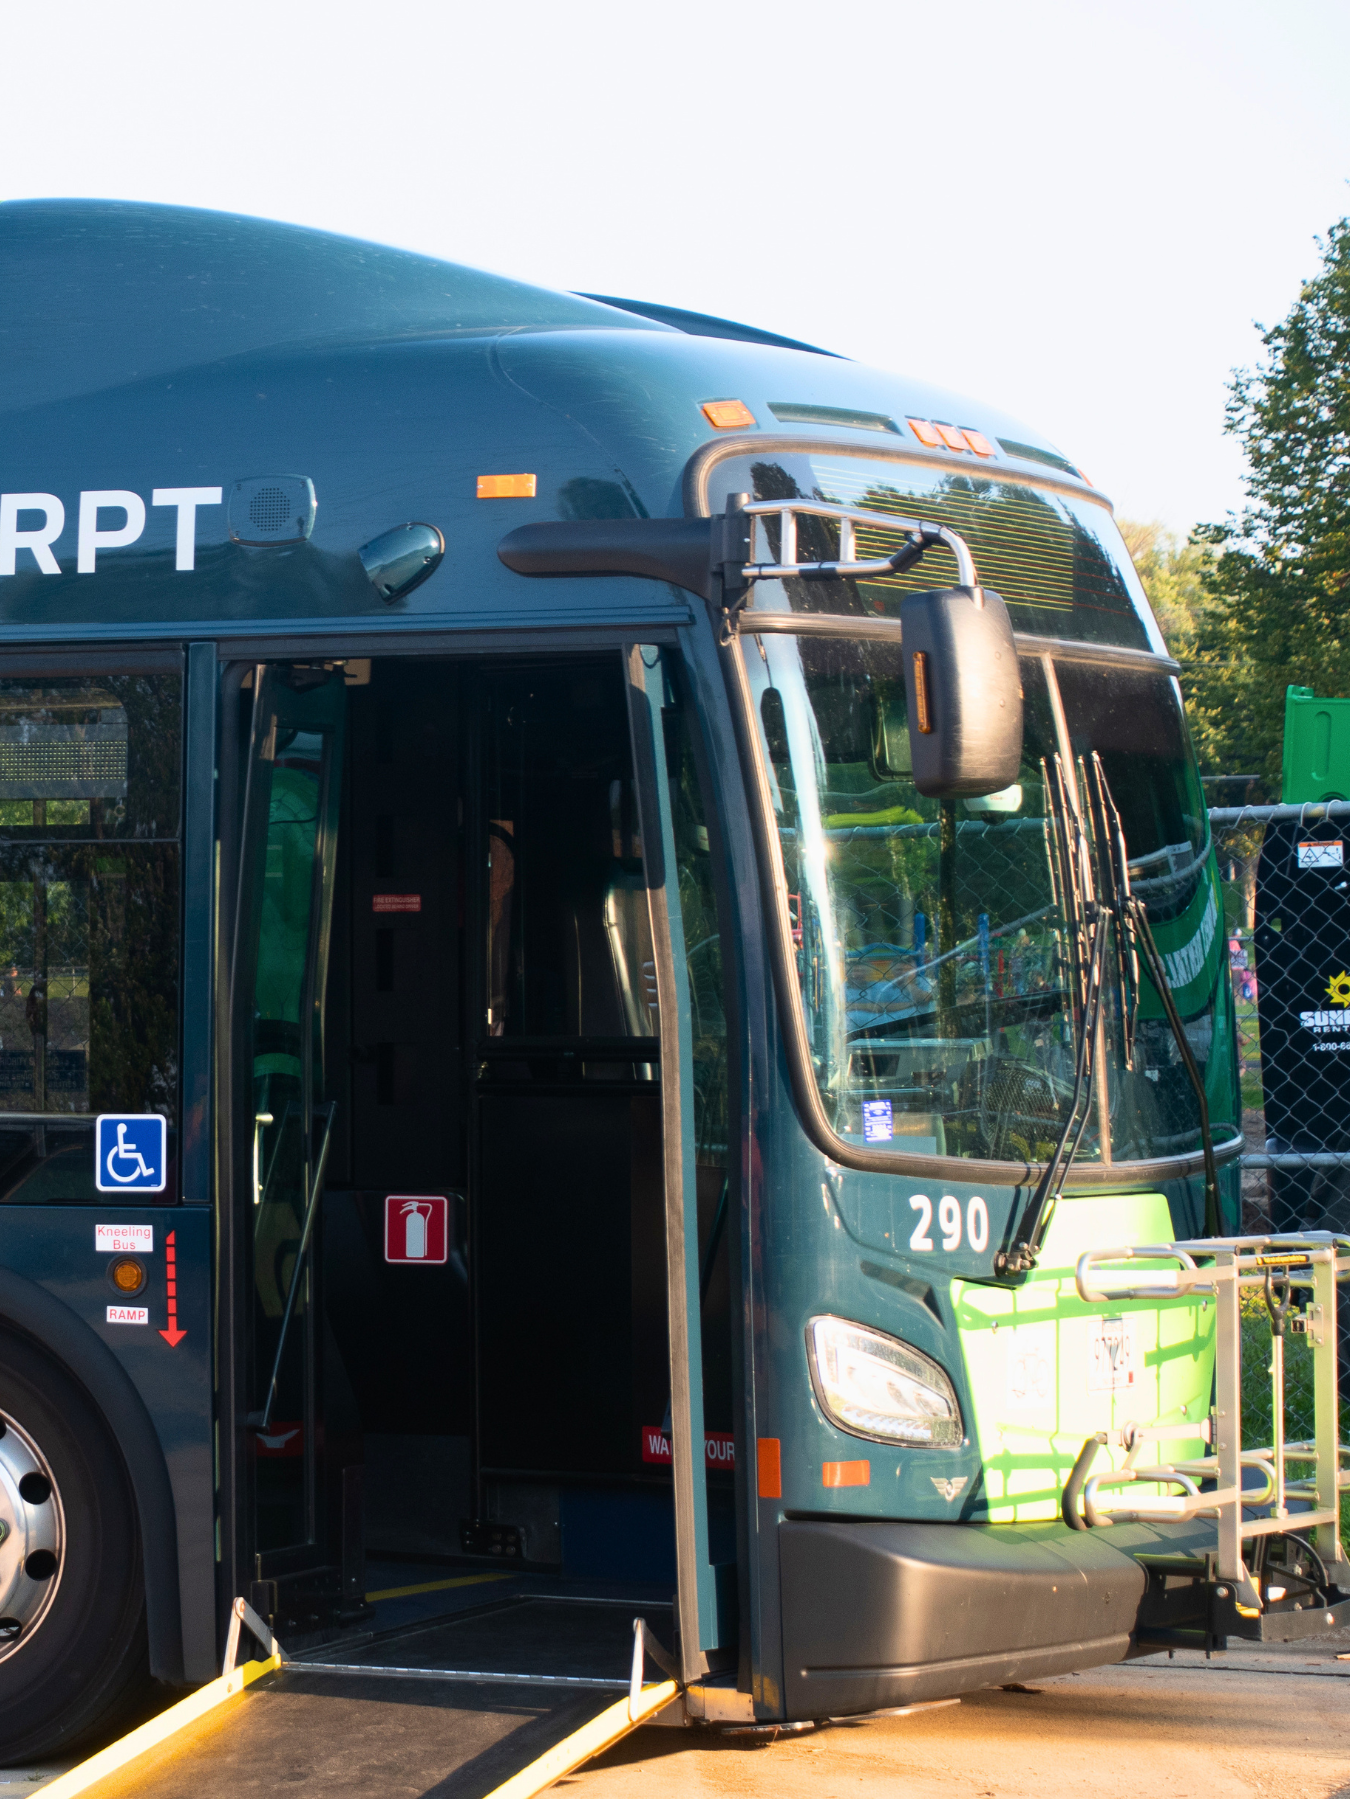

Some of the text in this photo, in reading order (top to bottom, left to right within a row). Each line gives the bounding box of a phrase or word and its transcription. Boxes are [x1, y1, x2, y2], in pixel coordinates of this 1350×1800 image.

[908, 1194, 989, 1253] 290
[97, 1226, 151, 1239] Kneeling
[113, 1239, 136, 1250] Bus
[109, 1308, 146, 1321] RAMP
